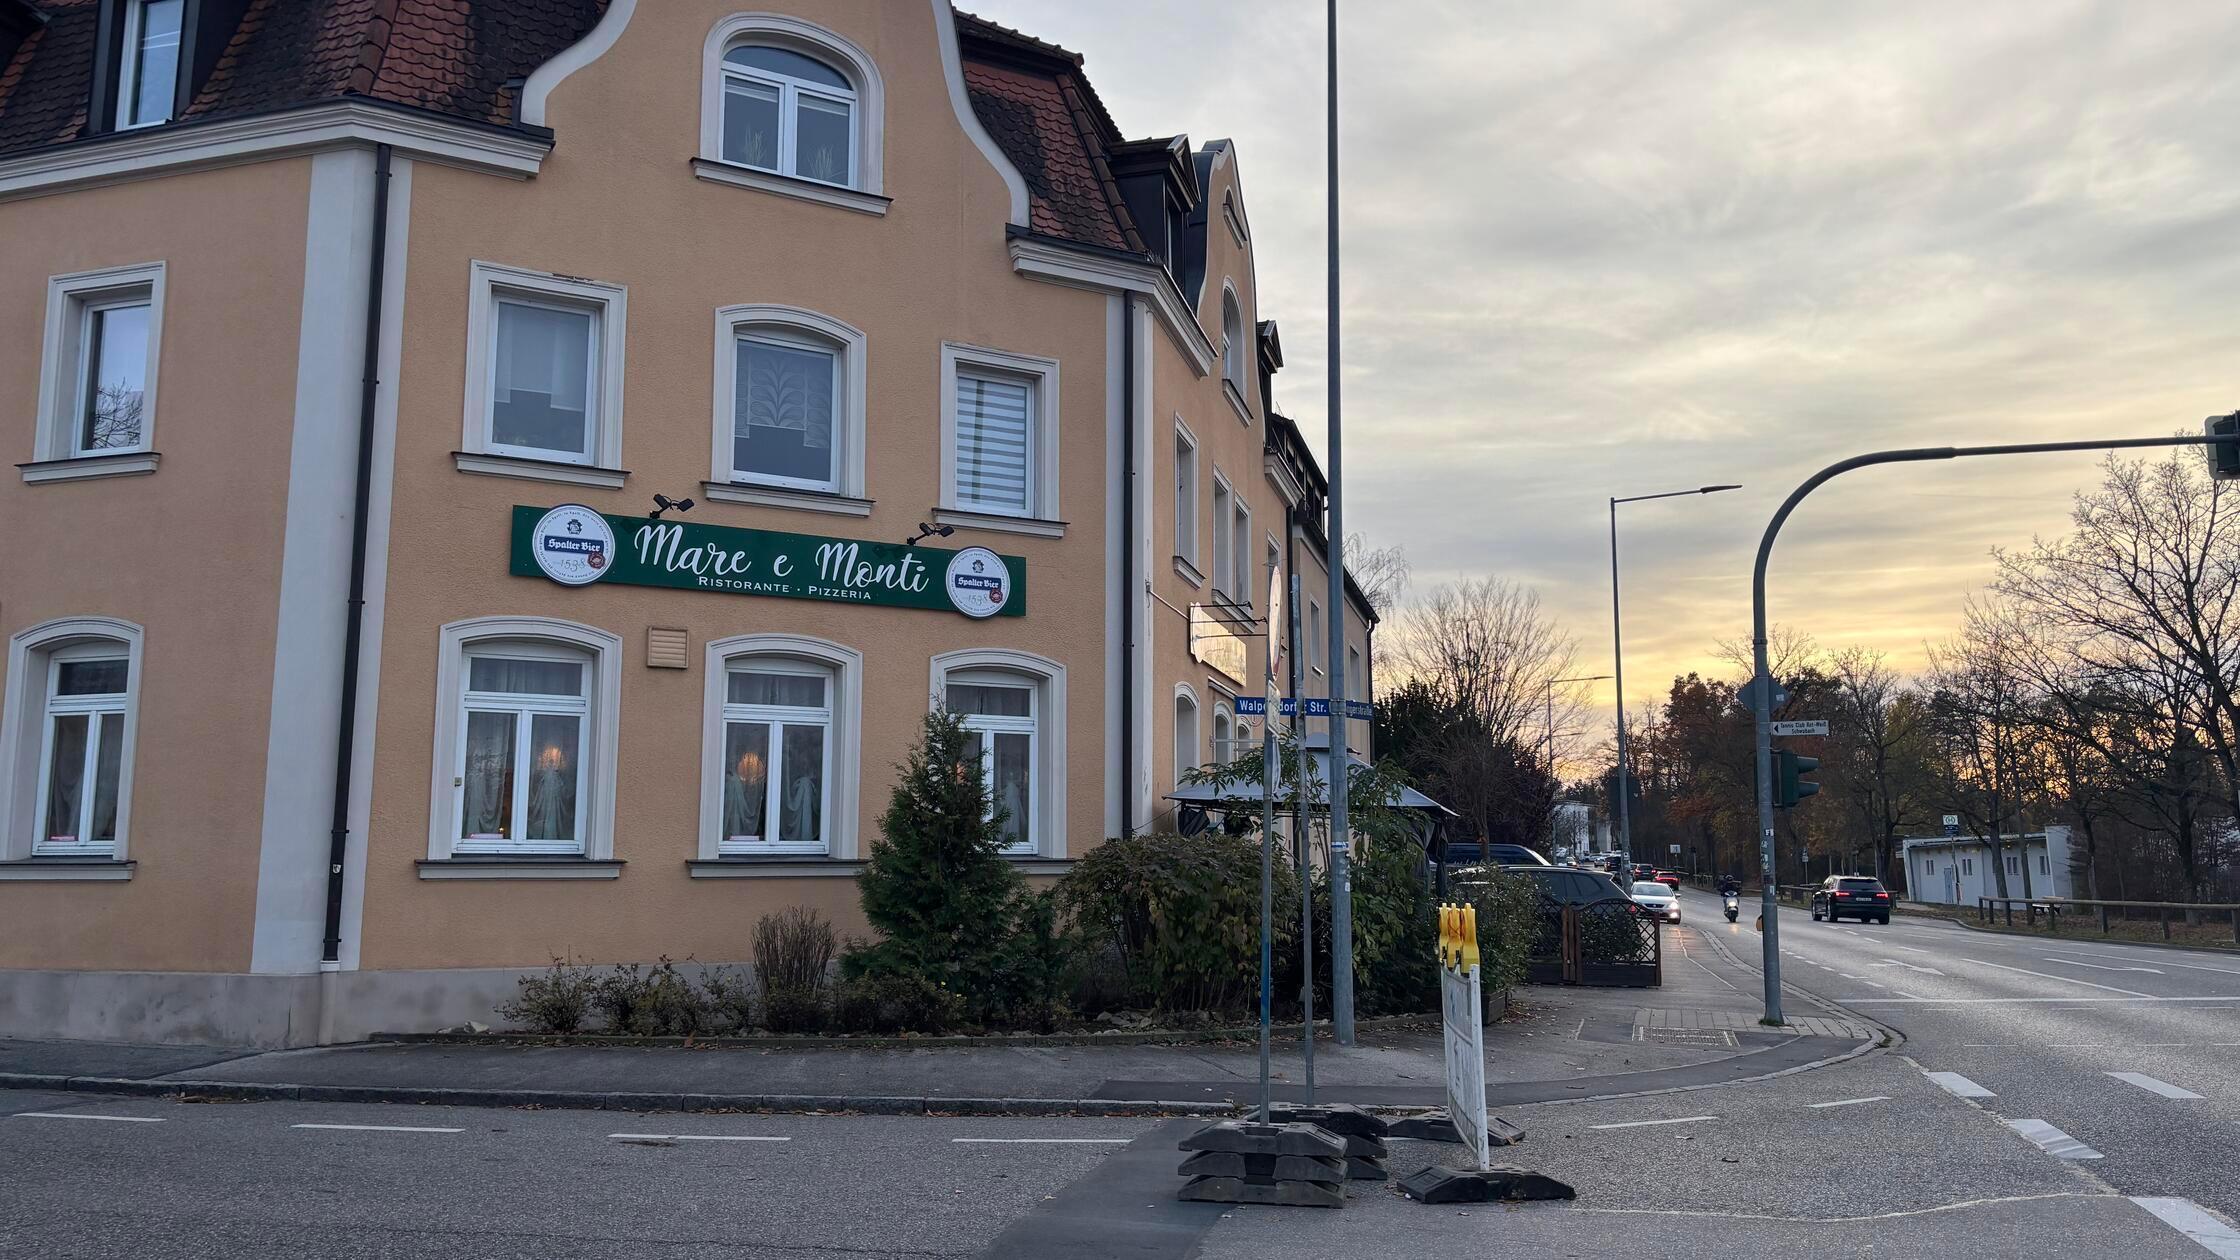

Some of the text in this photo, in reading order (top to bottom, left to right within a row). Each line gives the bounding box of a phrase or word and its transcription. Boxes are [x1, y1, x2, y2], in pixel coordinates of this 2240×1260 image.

[547, 538, 580, 550] Spalter
[581, 541, 601, 552] Bier
[634, 524, 752, 576] Mare
[773, 554, 794, 577] e
[815, 542, 930, 592] Monti
[560, 559, 586, 573] 1538
[699, 576, 872, 600] RISTORANTE PIZZERIA
[957, 576, 999, 589] Spalter Bier
[1310, 701, 1327, 713] Str.
